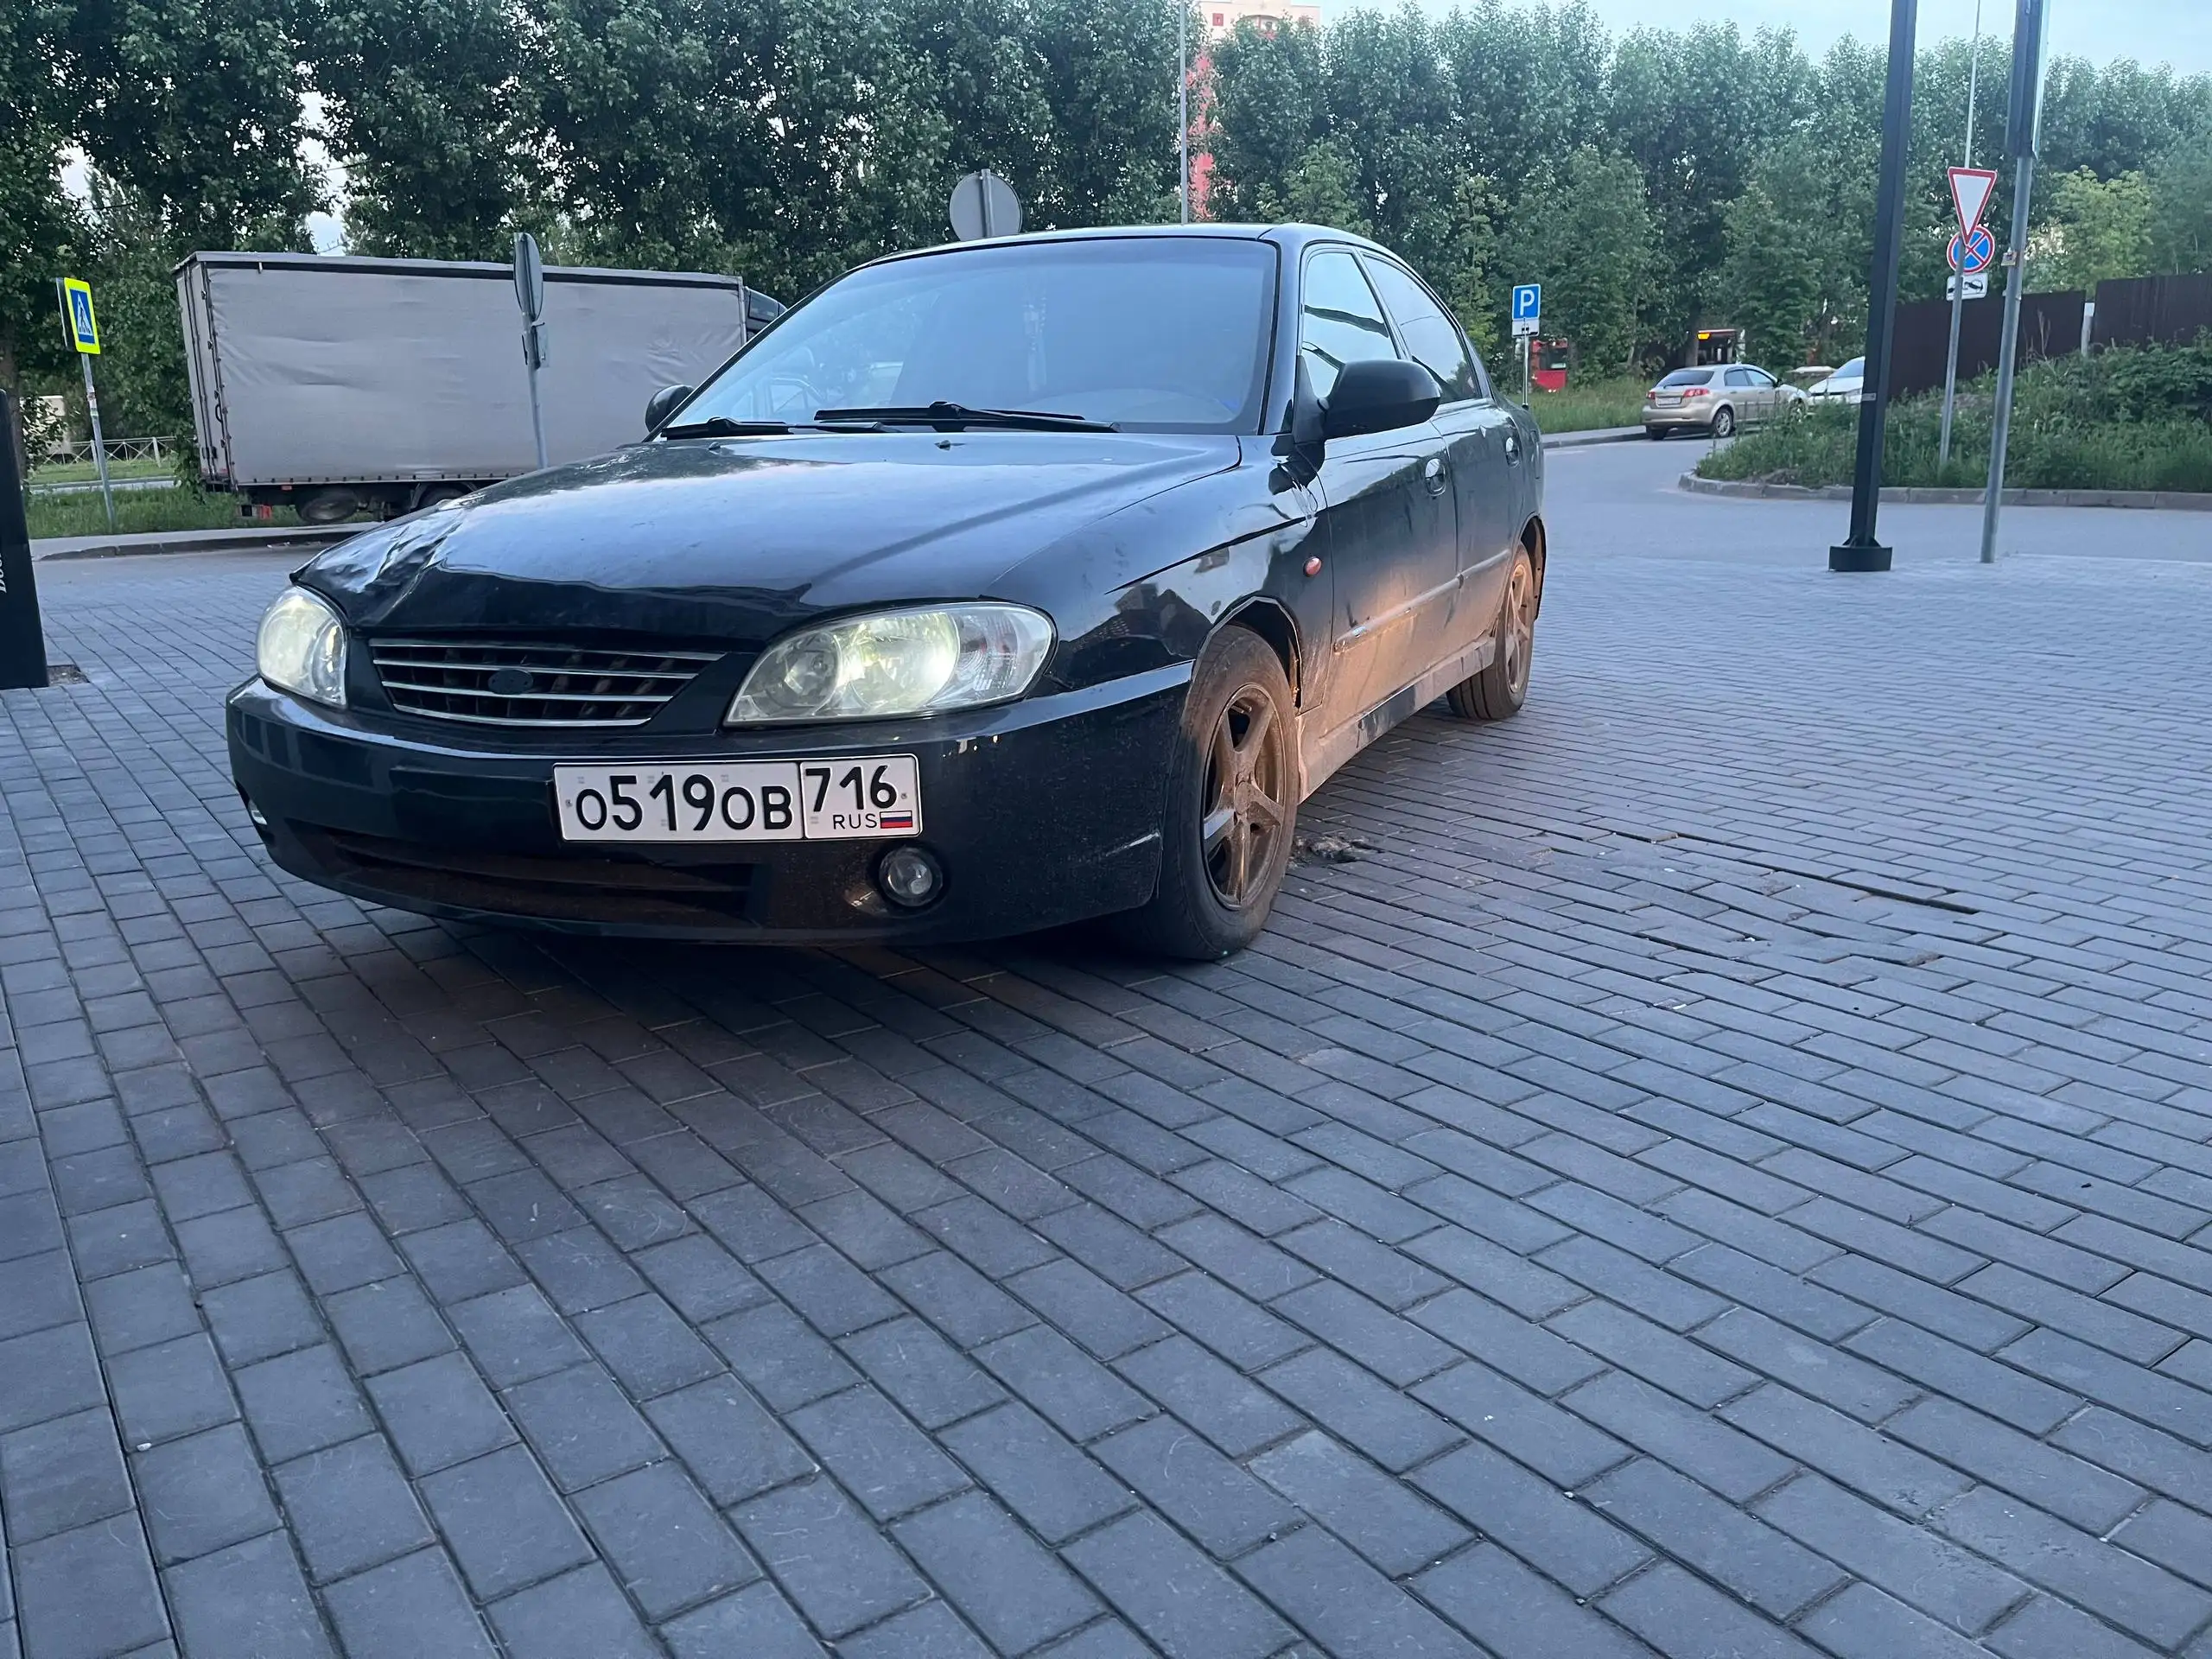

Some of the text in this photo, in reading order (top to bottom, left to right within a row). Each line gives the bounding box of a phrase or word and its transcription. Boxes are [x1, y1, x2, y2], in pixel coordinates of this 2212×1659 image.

[1520, 289, 1535, 315] P
[804, 765, 897, 812] 716
[832, 813, 878, 830] RUS
